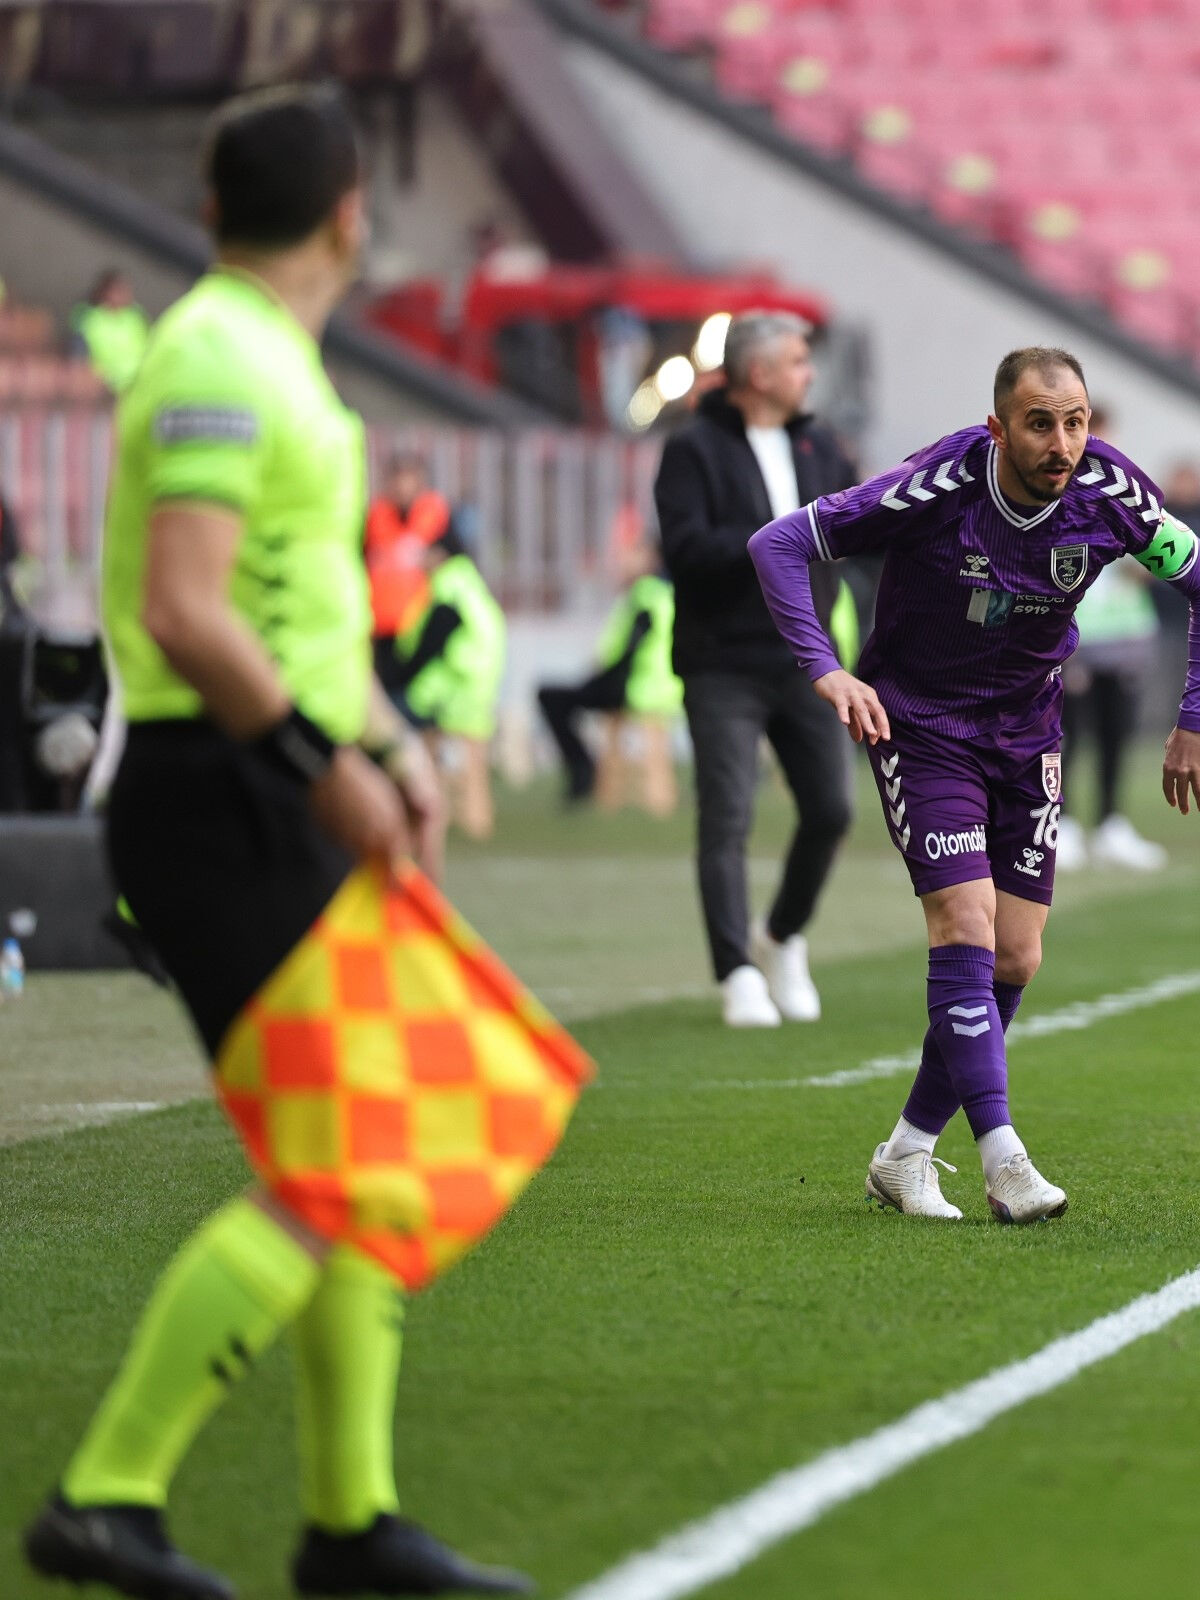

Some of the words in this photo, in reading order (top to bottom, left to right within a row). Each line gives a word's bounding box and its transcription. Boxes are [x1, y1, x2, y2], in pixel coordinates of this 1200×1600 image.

[959, 568, 989, 579] hummel
[1013, 605, 1049, 615] S919
[1030, 801, 1060, 850] 18
[1013, 860, 1042, 878] hummel
